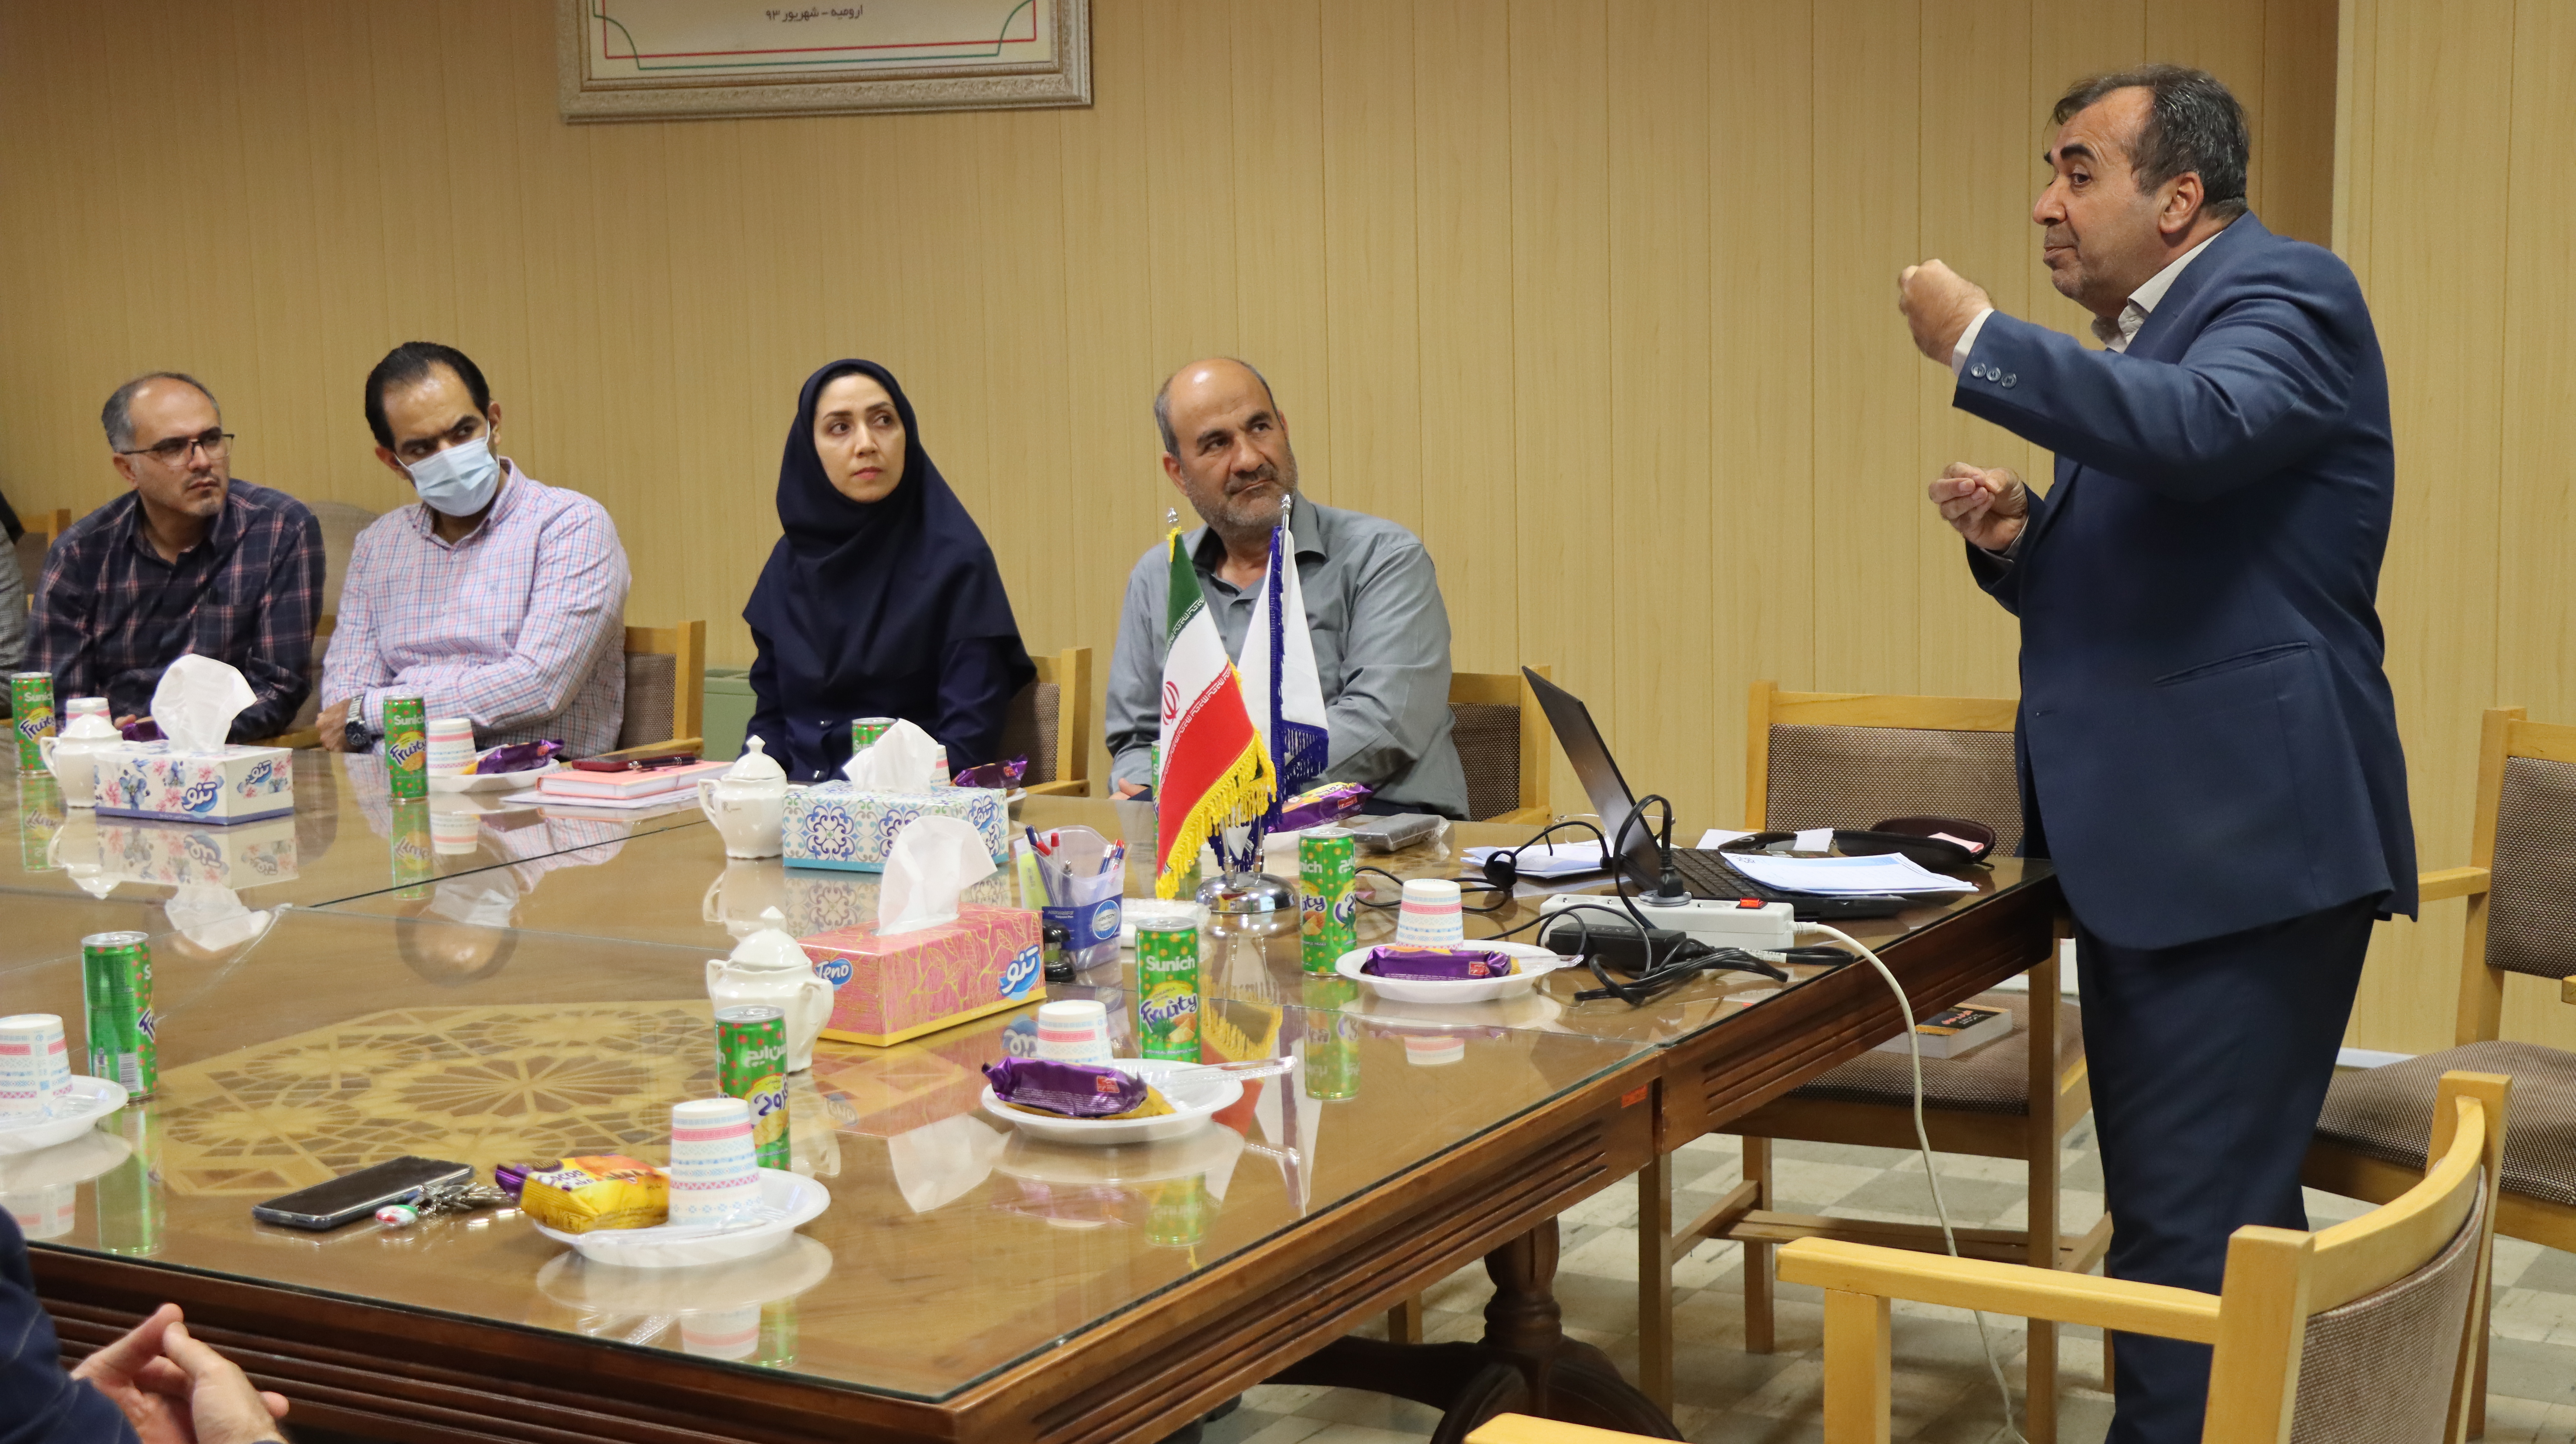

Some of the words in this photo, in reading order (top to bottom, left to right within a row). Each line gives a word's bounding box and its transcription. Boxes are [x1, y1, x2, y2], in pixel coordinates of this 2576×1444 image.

[782, 6, 819, 22] شهریور
[248, 760, 272, 784] تنو
[182, 781, 217, 811] تنو
[817, 961, 849, 980] Teno
[1001, 946, 1039, 994] تنو
[1146, 955, 1196, 972] Sunich
[1141, 995, 1197, 1028] Fruity
